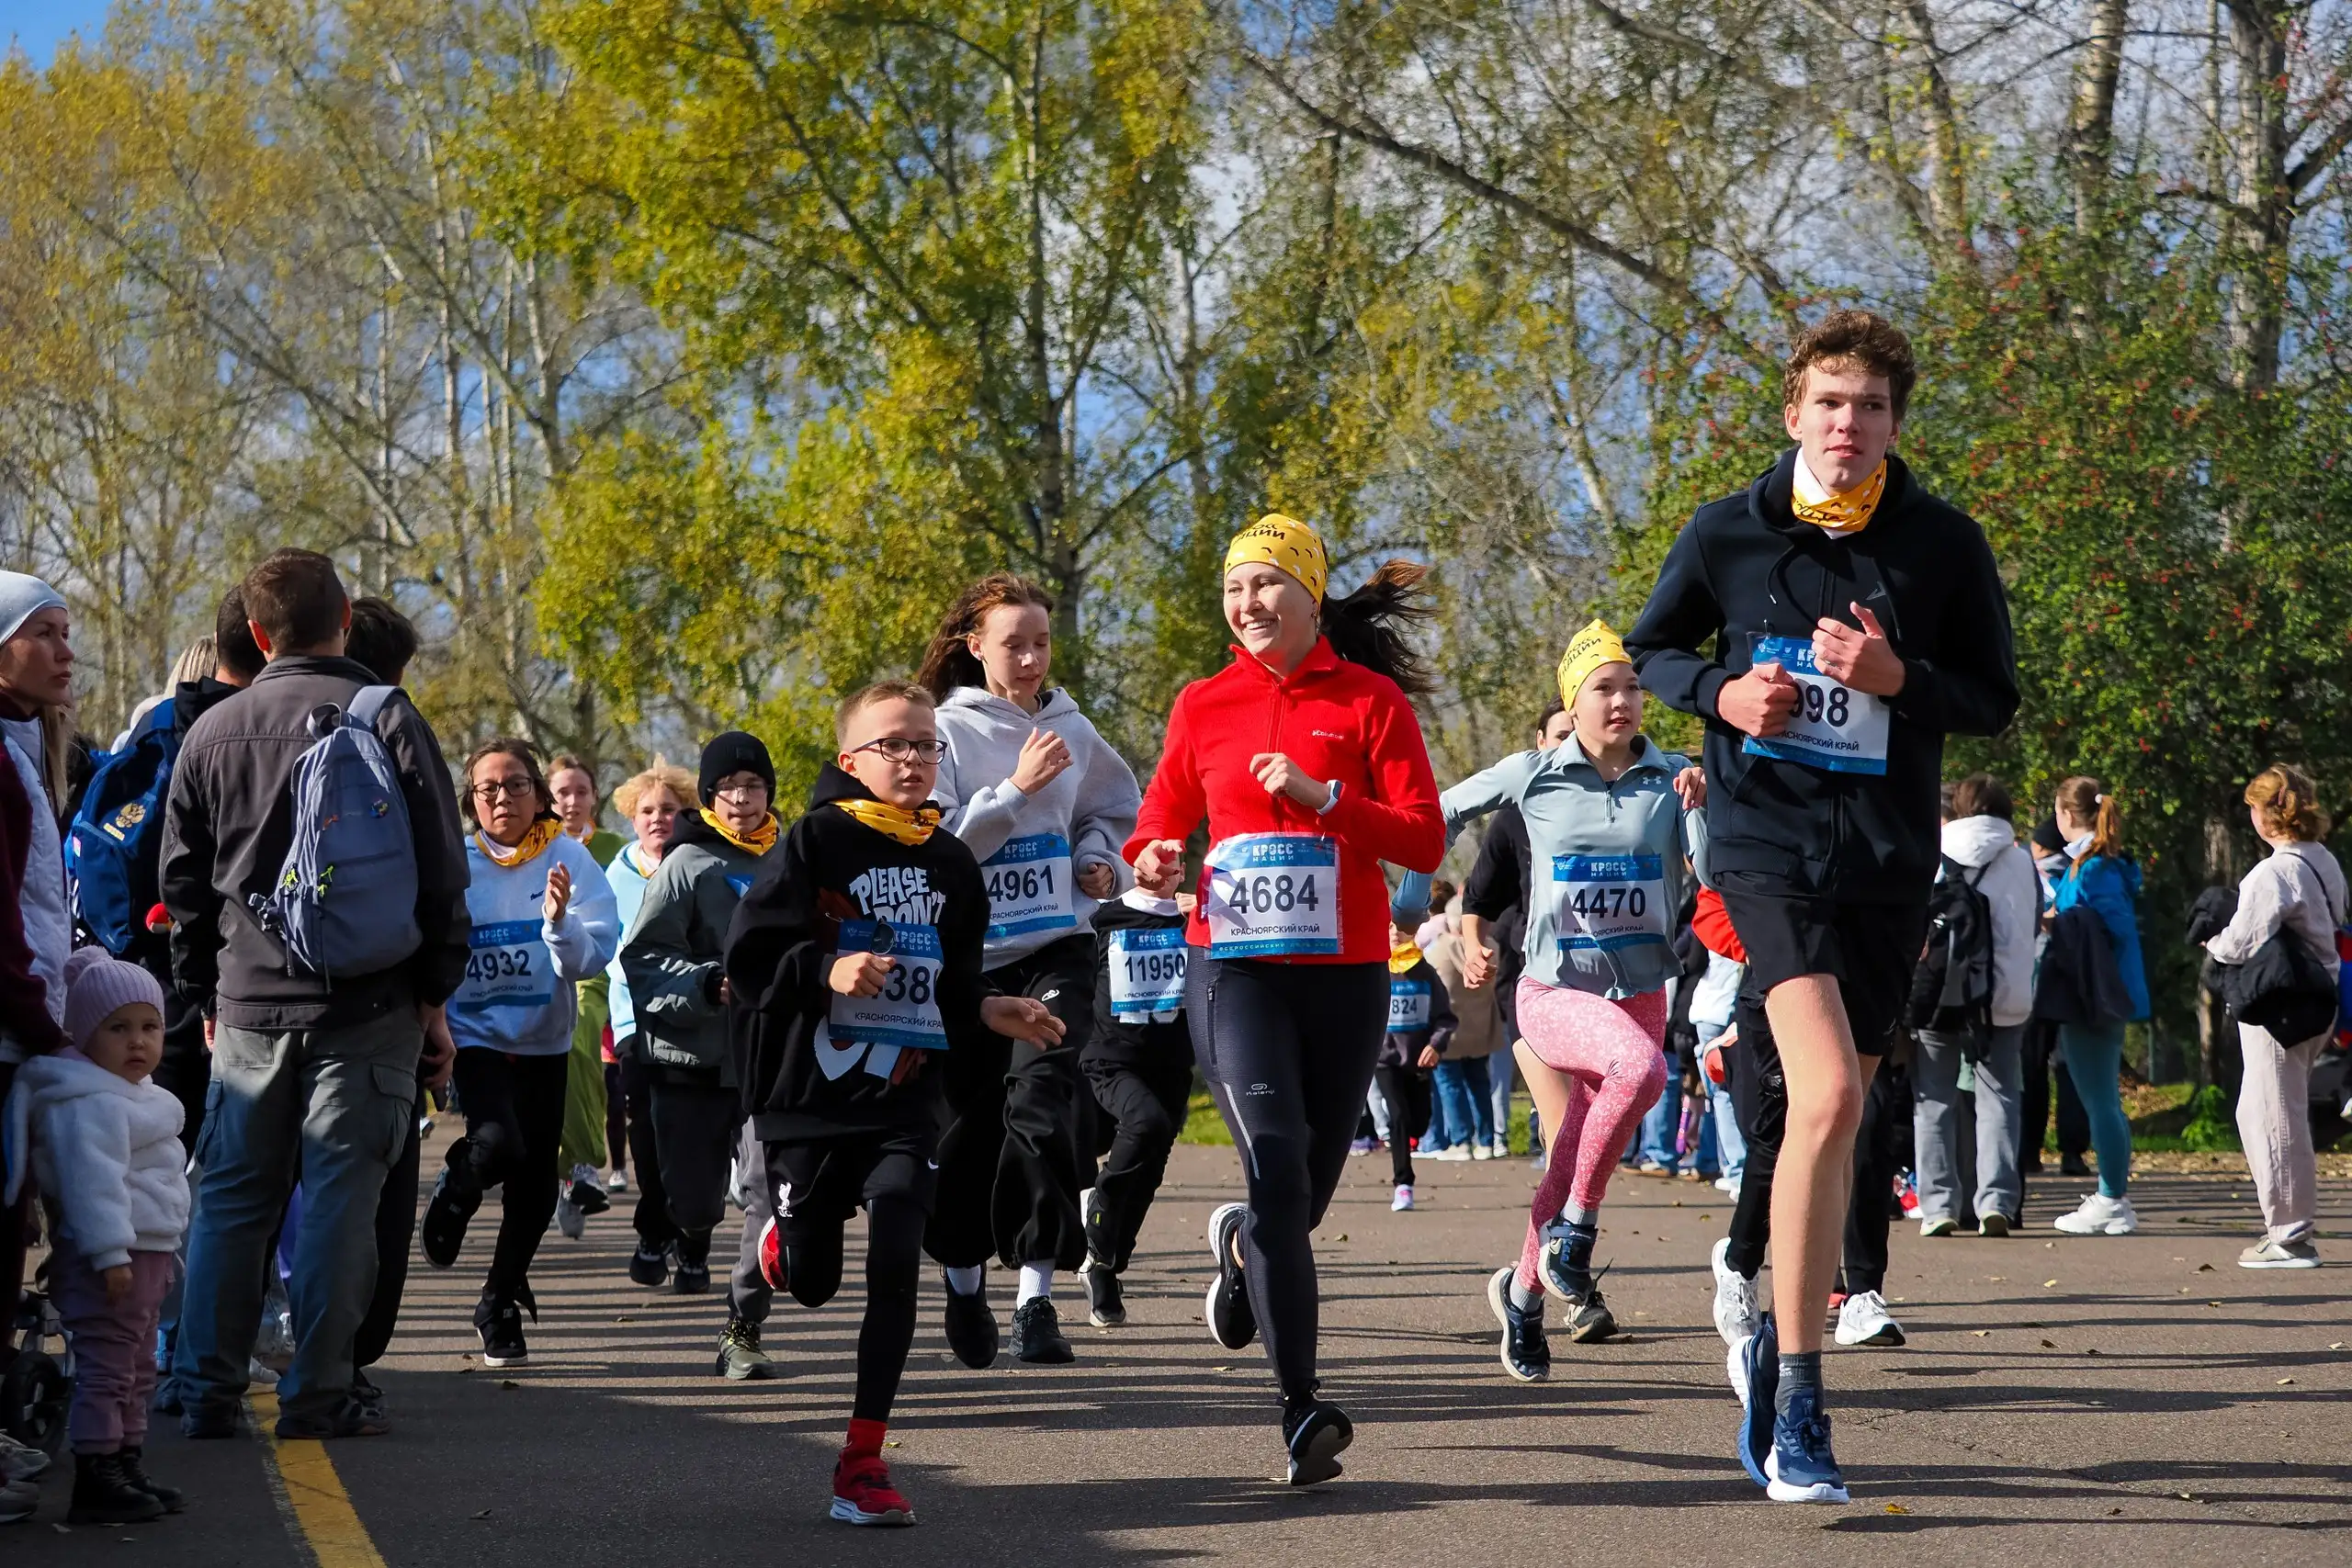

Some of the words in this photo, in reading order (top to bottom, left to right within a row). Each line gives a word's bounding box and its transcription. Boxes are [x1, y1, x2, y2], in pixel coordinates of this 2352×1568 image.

[1781, 730, 1833, 749] АСНОЯРСКИЙ
[1835, 741, 1860, 751] КРАЙ
[1004, 841, 1037, 854] КРОСС
[1252, 843, 1294, 856] КРОСС
[1590, 862, 1627, 872] КРОСС
[849, 866, 930, 916] PLEASE
[988, 864, 1054, 902] 4961
[1229, 874, 1318, 914] 4684
[1043, 902, 1059, 912] КРАЙ
[1572, 887, 1645, 919] 4470
[479, 929, 509, 940] КРОСС
[1231, 924, 1296, 936] КРАСНОЯРСКИЙ
[1297, 923, 1320, 933] КРАЙ
[895, 931, 931, 945] КРОСС
[1138, 934, 1168, 943] КРОСС
[467, 949, 532, 982] 4932
[1125, 953, 1186, 982] 11950
[1392, 998, 1418, 1014] 824
[854, 1012, 926, 1027] КРАСНОЯРСКИЙ
[927, 1020, 943, 1029] КРА
